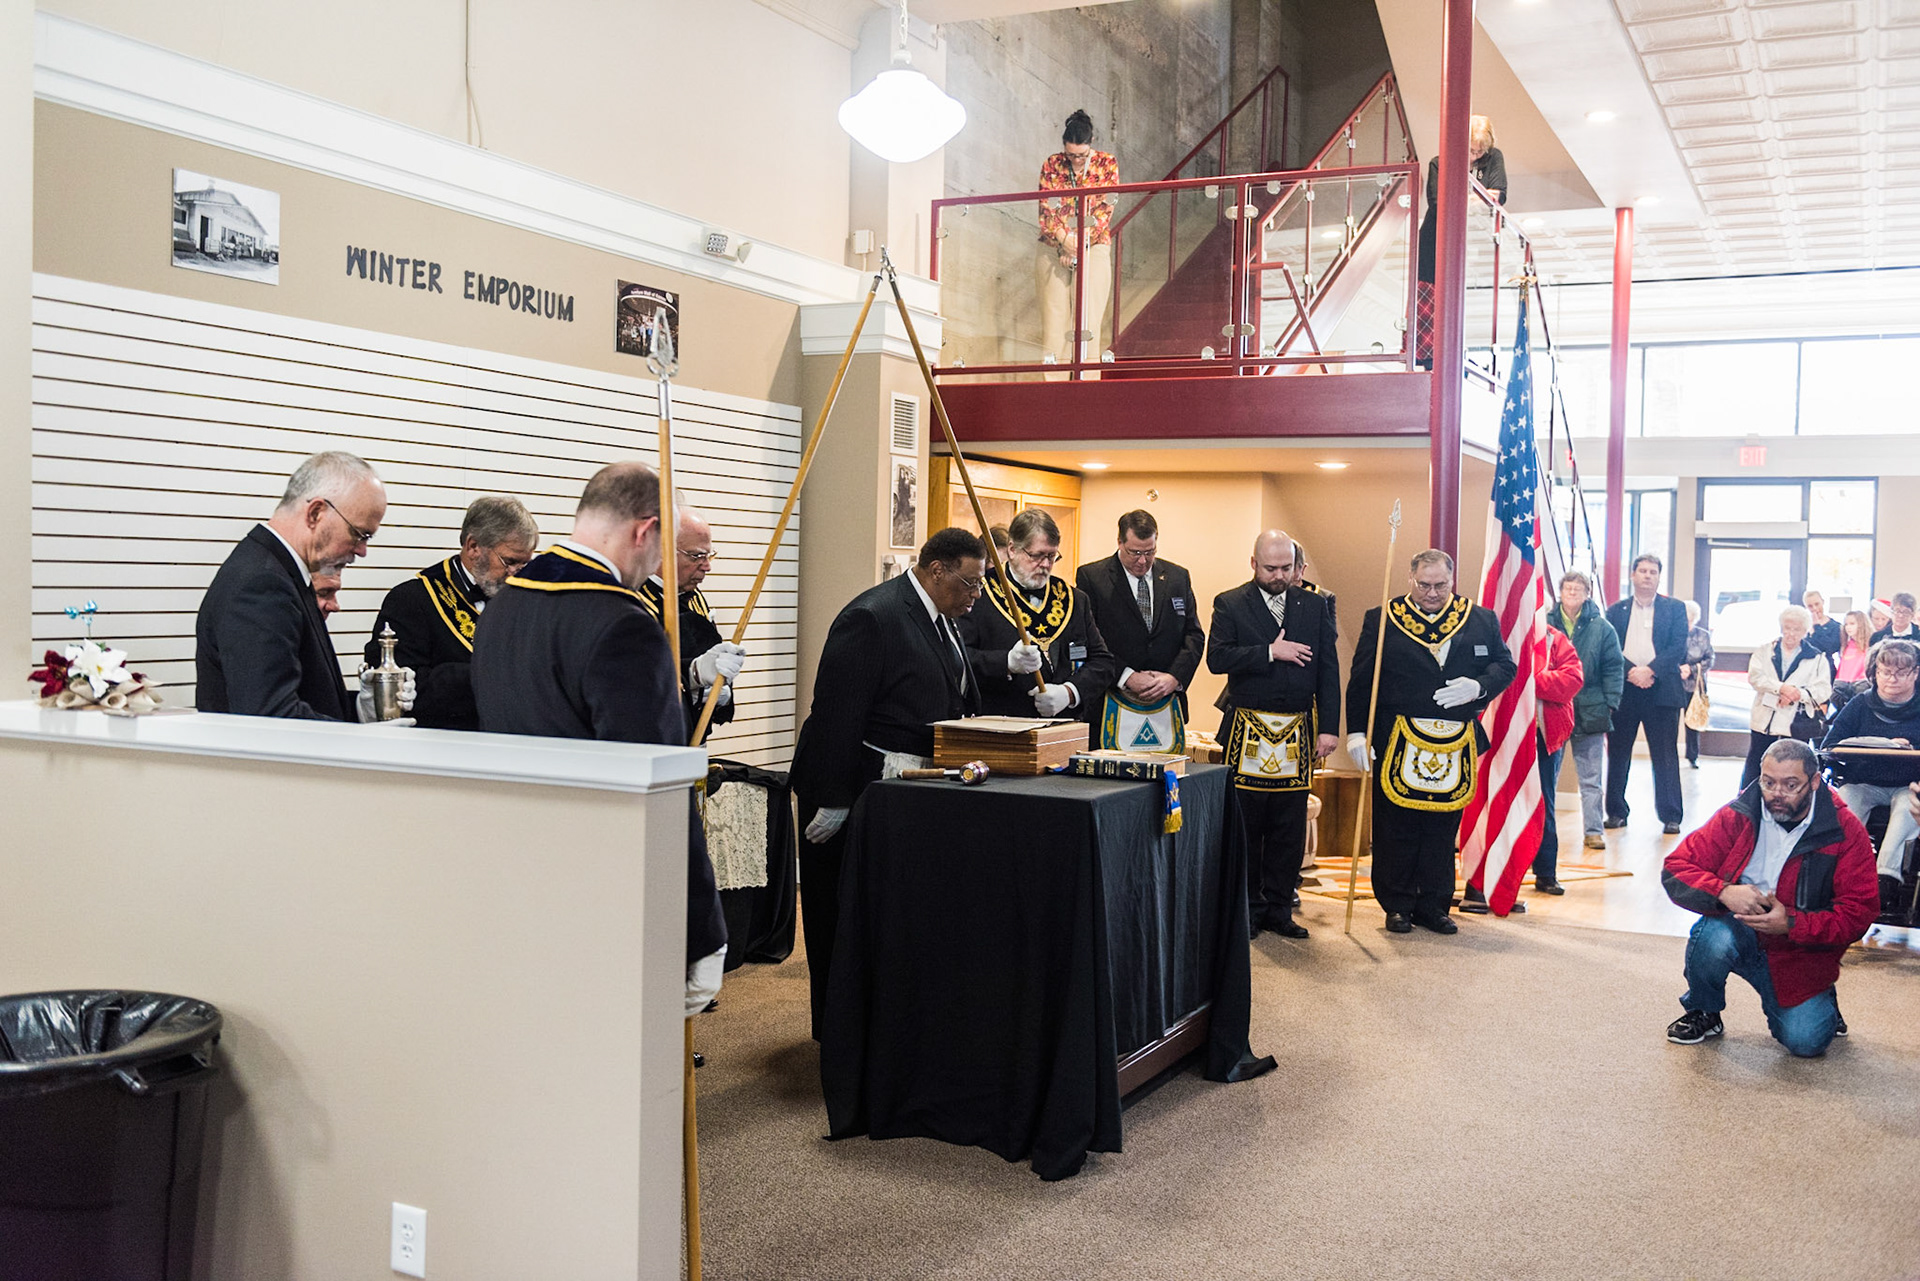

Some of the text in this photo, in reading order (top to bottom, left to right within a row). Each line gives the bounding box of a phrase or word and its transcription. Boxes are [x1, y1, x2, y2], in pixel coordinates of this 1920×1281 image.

[346, 245, 574, 322] WINTER EMPORIUM
[1740, 447, 1767, 466] EXIT
